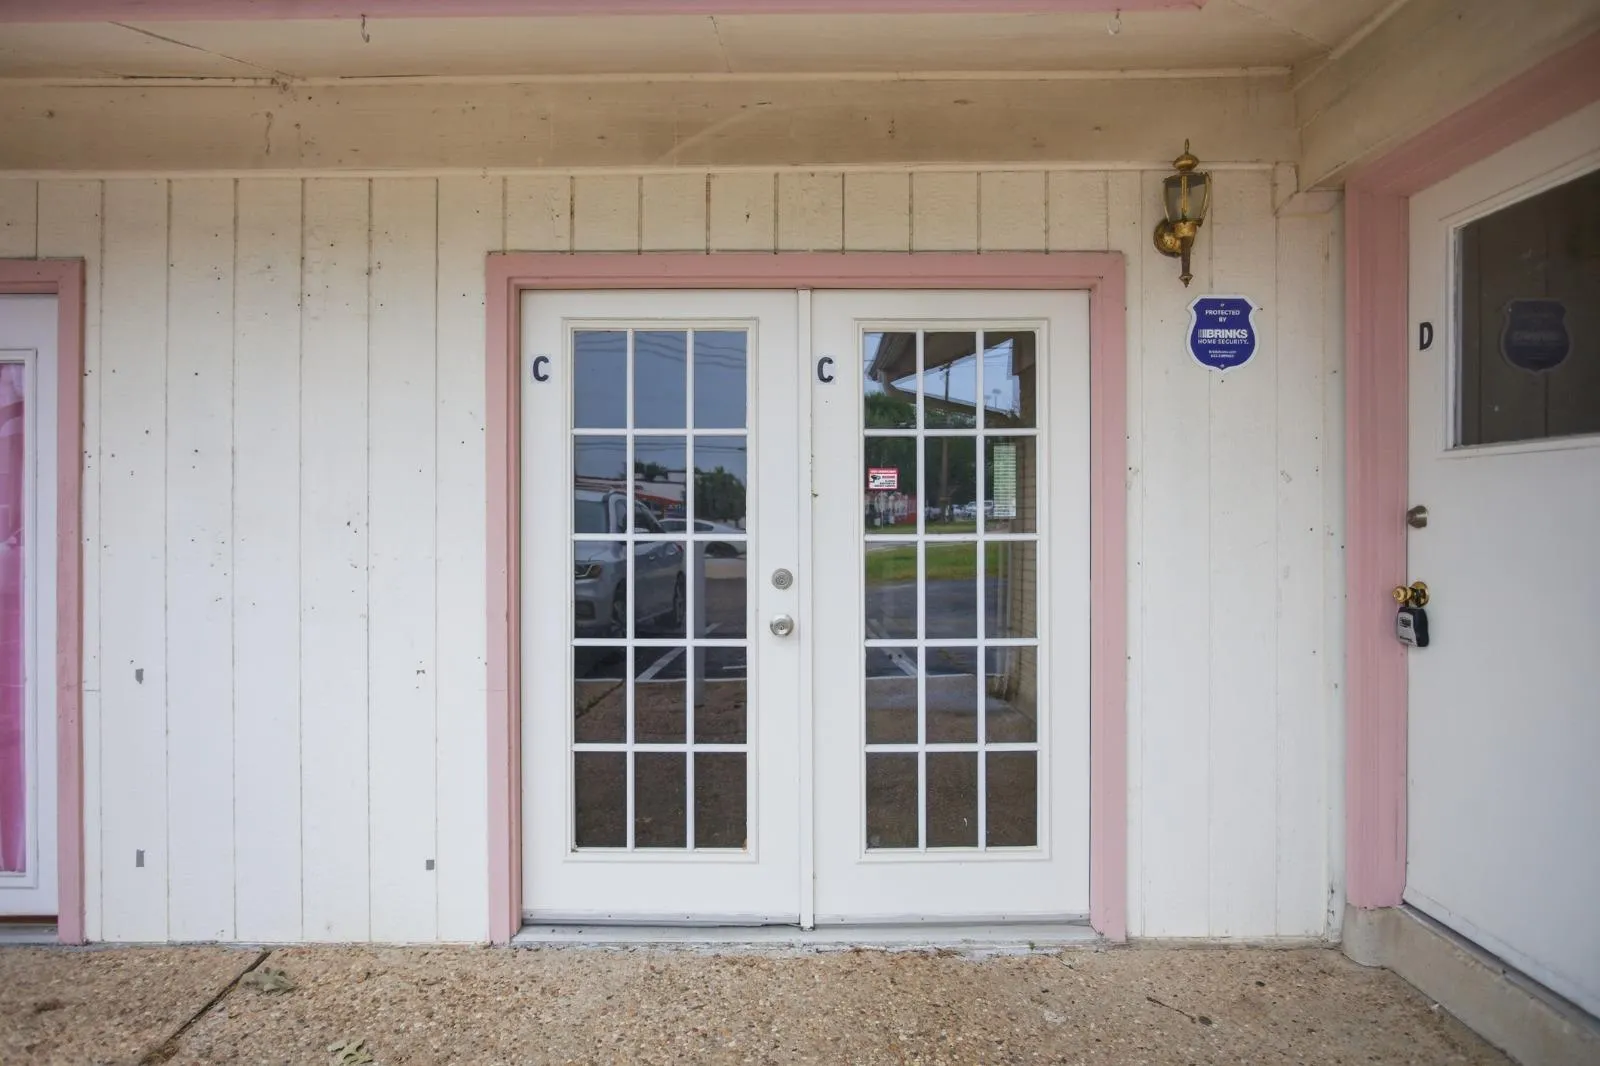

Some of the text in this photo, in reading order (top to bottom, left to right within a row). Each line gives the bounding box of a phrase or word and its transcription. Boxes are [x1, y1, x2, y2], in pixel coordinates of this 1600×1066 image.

[1206, 328, 1248, 339] BRINKS
[1419, 321, 1434, 351] D
[532, 355, 550, 382] C
[816, 356, 834, 383] C
